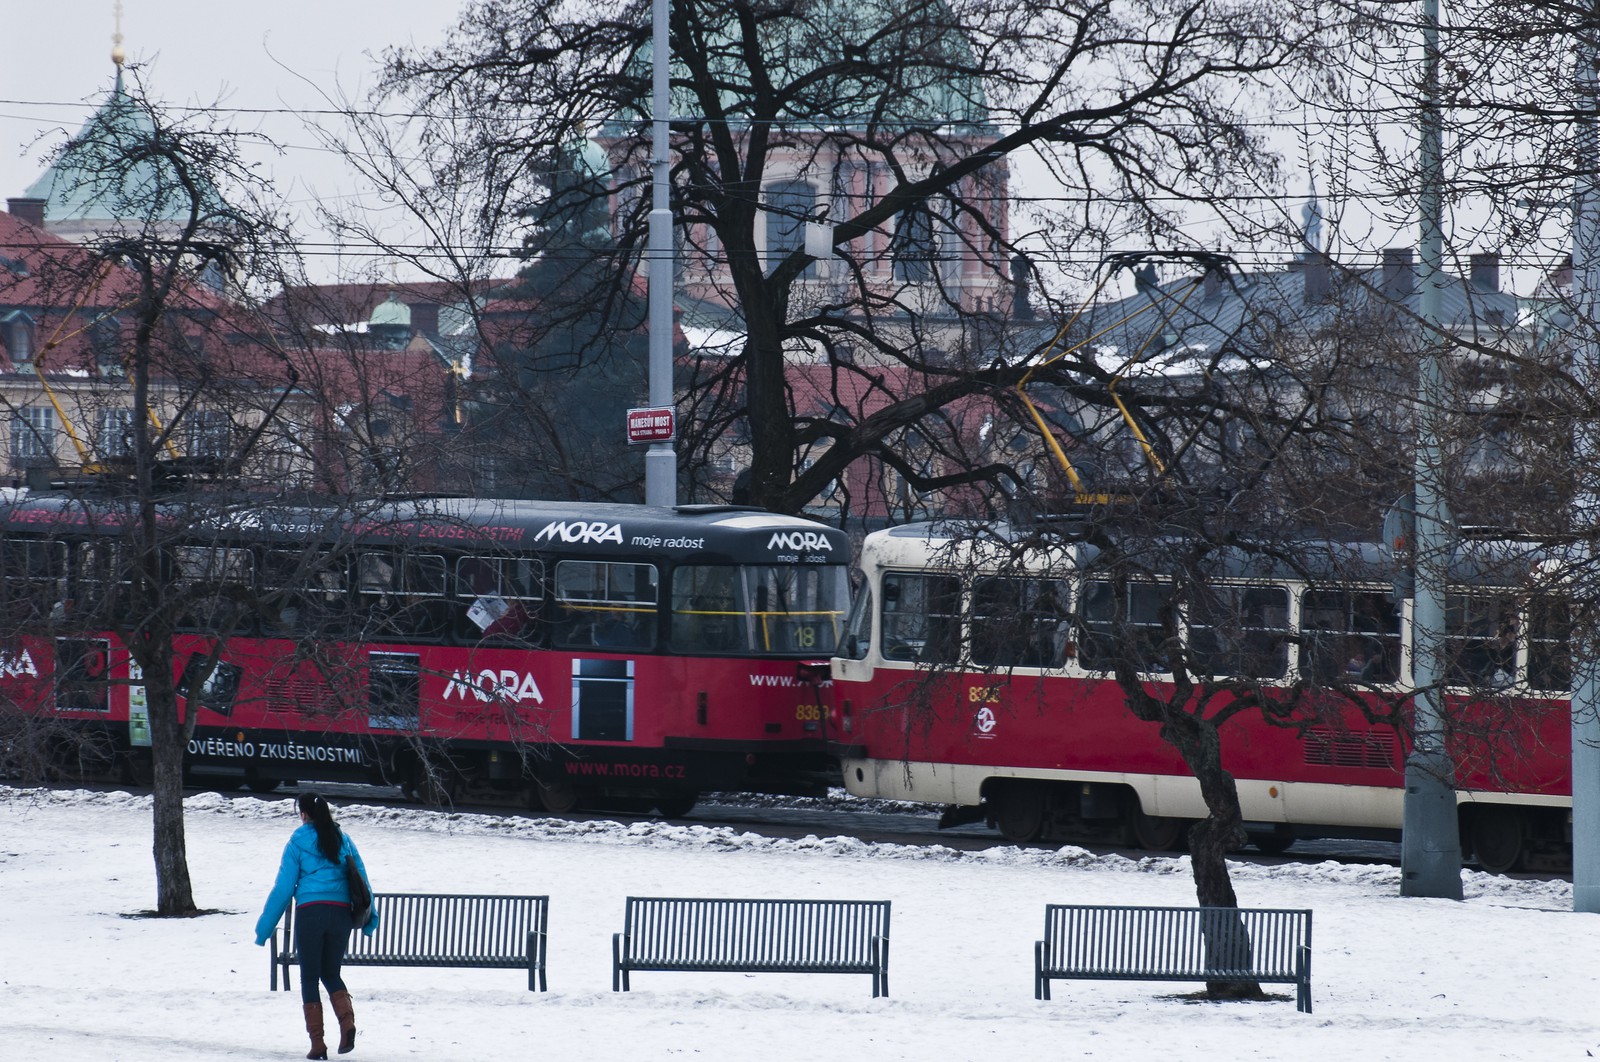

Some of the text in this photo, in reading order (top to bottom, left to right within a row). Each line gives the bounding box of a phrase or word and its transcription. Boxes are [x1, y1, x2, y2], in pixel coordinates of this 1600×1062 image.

[654, 416, 670, 428] MOST
[533, 521, 624, 545] MORA
[631, 534, 704, 550] moje radost
[766, 531, 833, 552] MORA
[777, 553, 826, 564] moje adost
[794, 627, 815, 647] 18
[442, 668, 544, 705] MORA
[187, 737, 361, 764] OVĚŘENO ZKUŠENOSTMI
[565, 762, 686, 779] www.mora.cz
